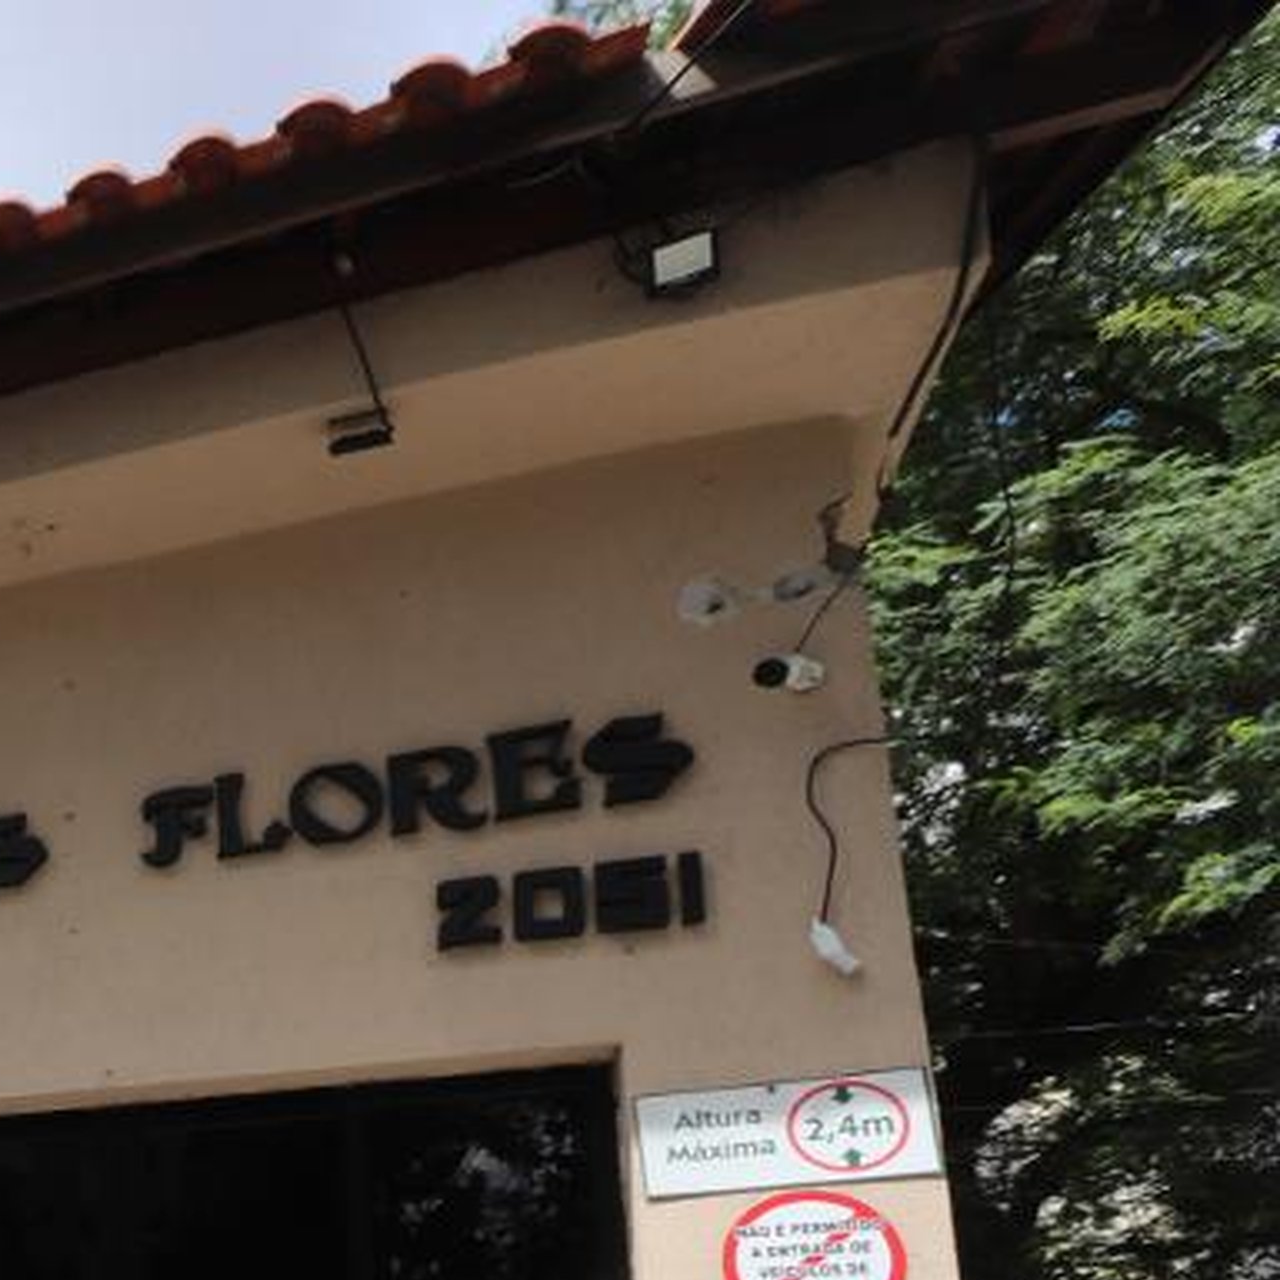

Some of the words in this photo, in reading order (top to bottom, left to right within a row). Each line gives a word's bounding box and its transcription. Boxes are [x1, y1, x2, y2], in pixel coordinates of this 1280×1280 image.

[138, 711, 694, 870] FLORES
[675, 1109, 762, 1131] Altura
[803, 1113, 895, 1144] 2,4m
[667, 1139, 776, 1163] Máxima
